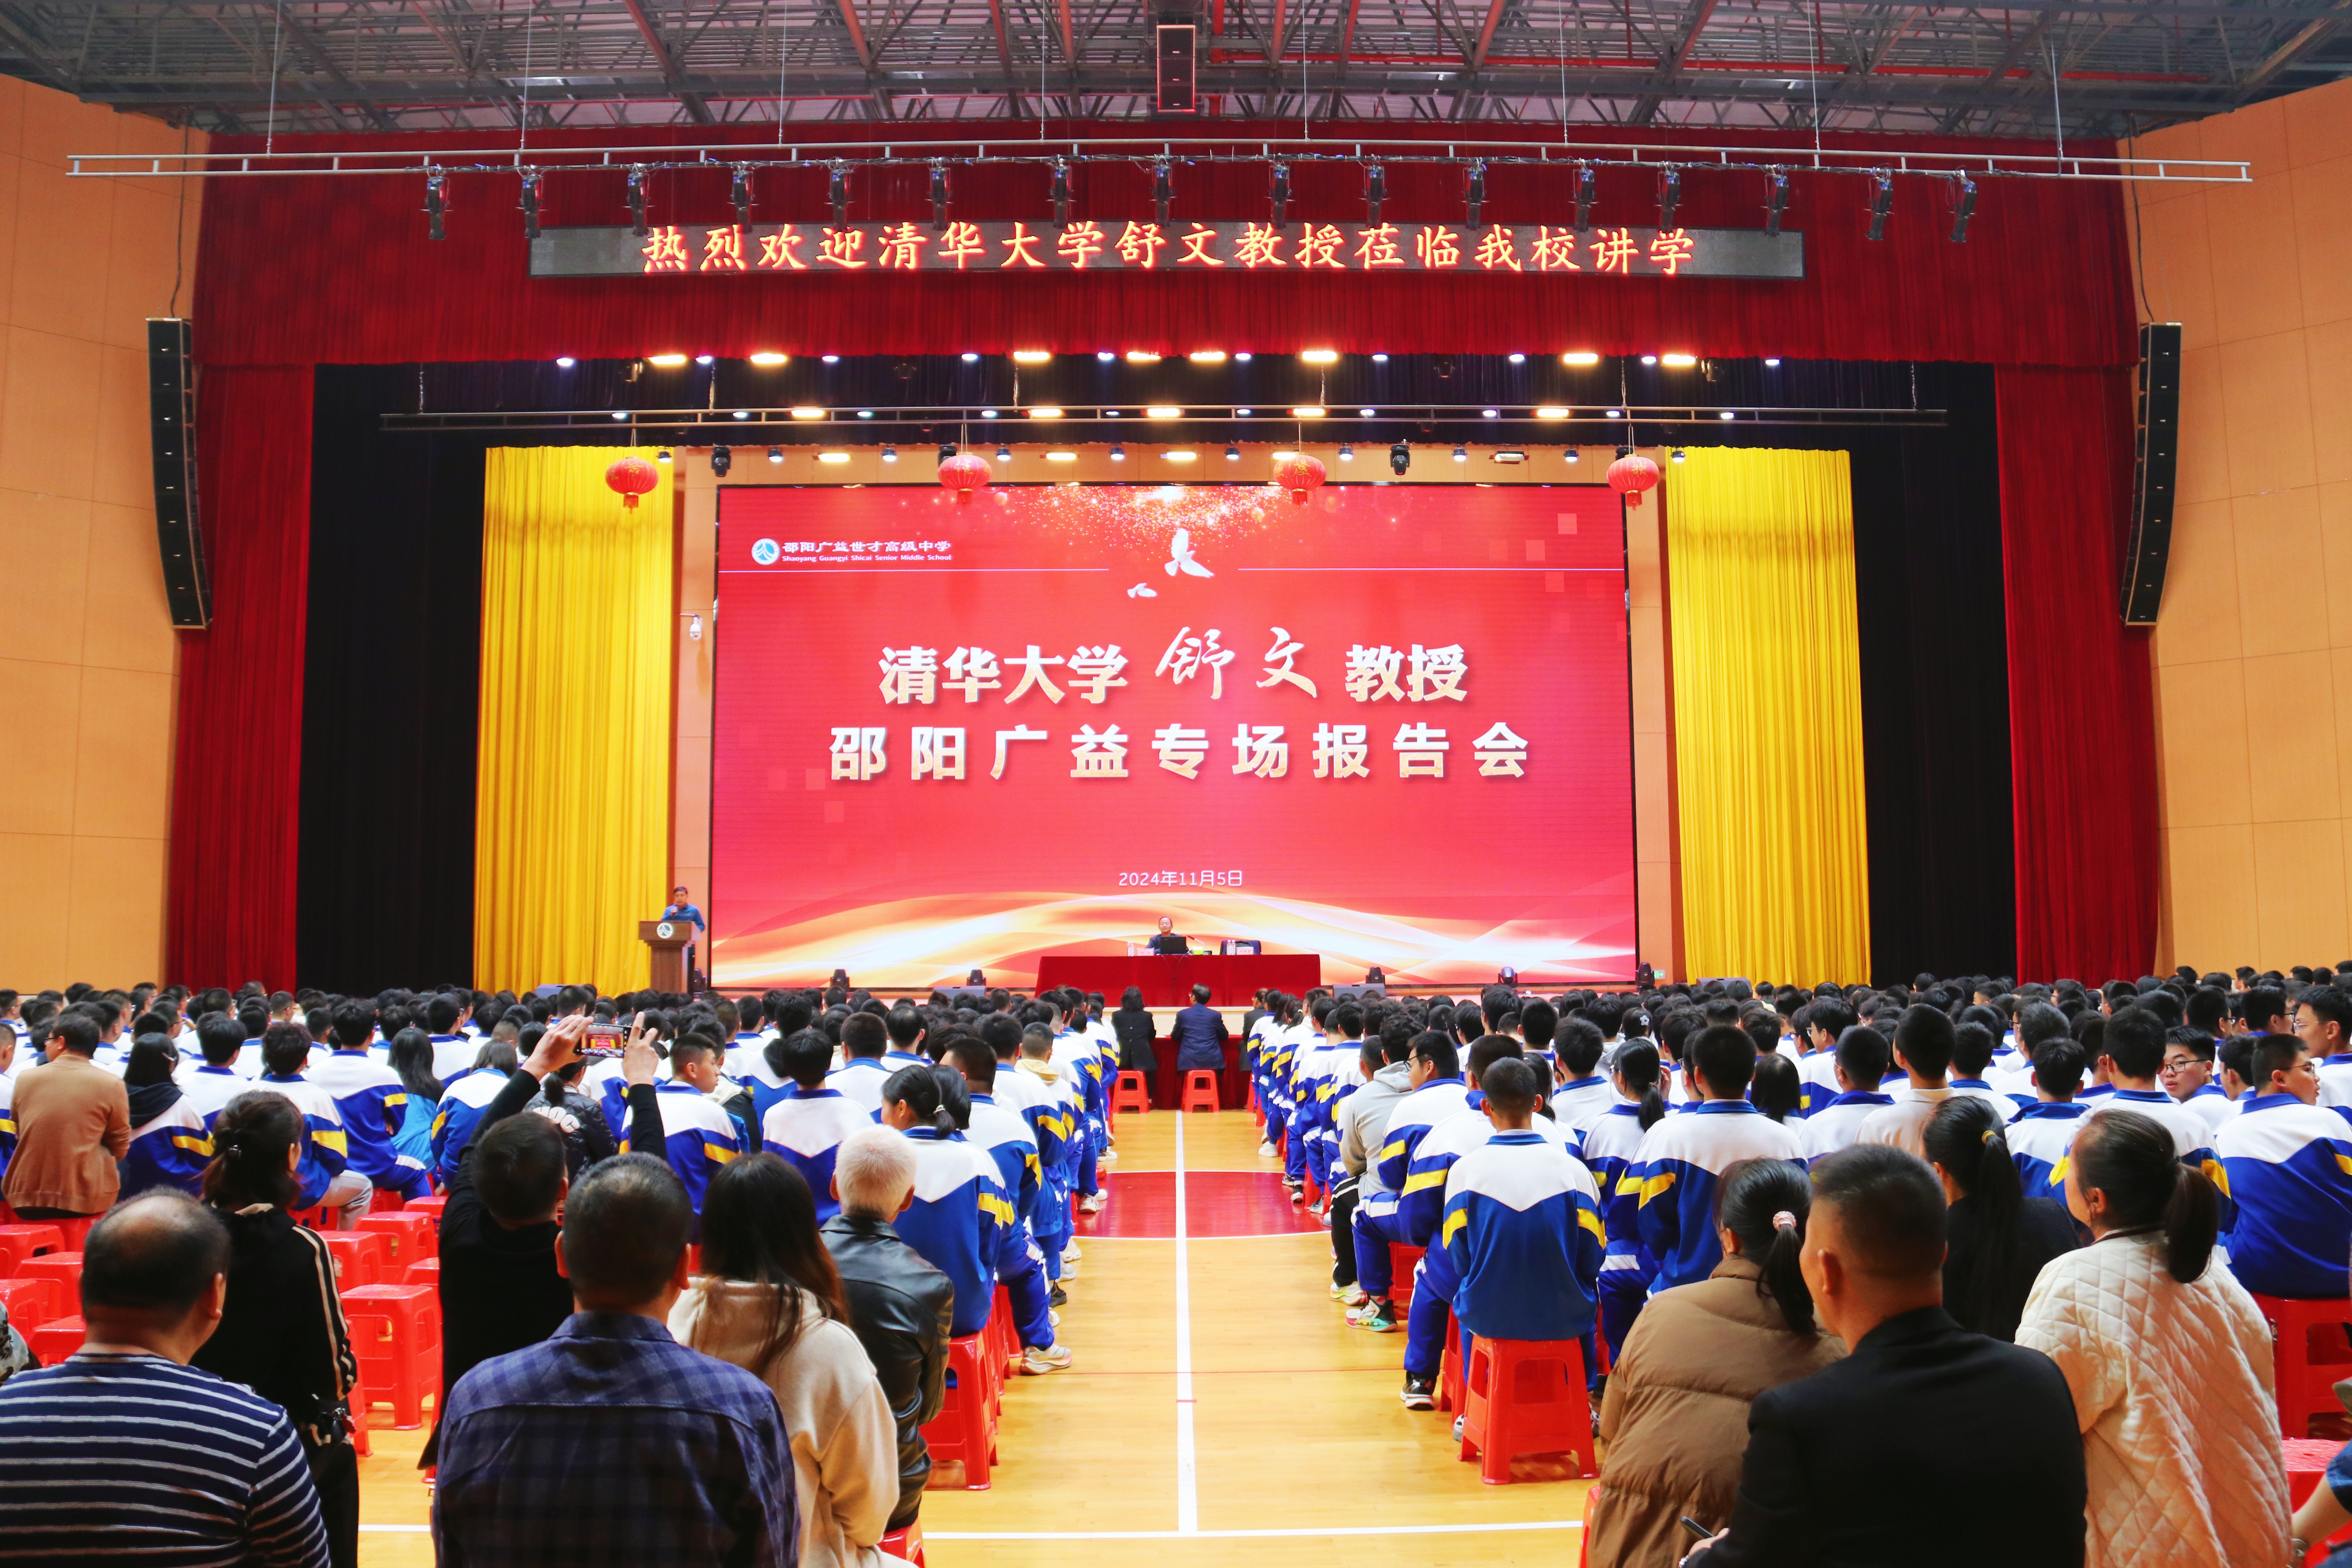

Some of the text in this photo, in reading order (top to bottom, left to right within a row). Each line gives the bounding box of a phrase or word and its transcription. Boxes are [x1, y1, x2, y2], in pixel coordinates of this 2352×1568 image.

[641, 221, 1694, 274] 热烈欢迎清华大学舒文教授莅临我校讲学
[782, 541, 951, 554] 邵阳广益世才高级中学
[829, 722, 1528, 781] 邵阳广益专场报告会
[1119, 870, 1242, 887] 2024年11月5日
